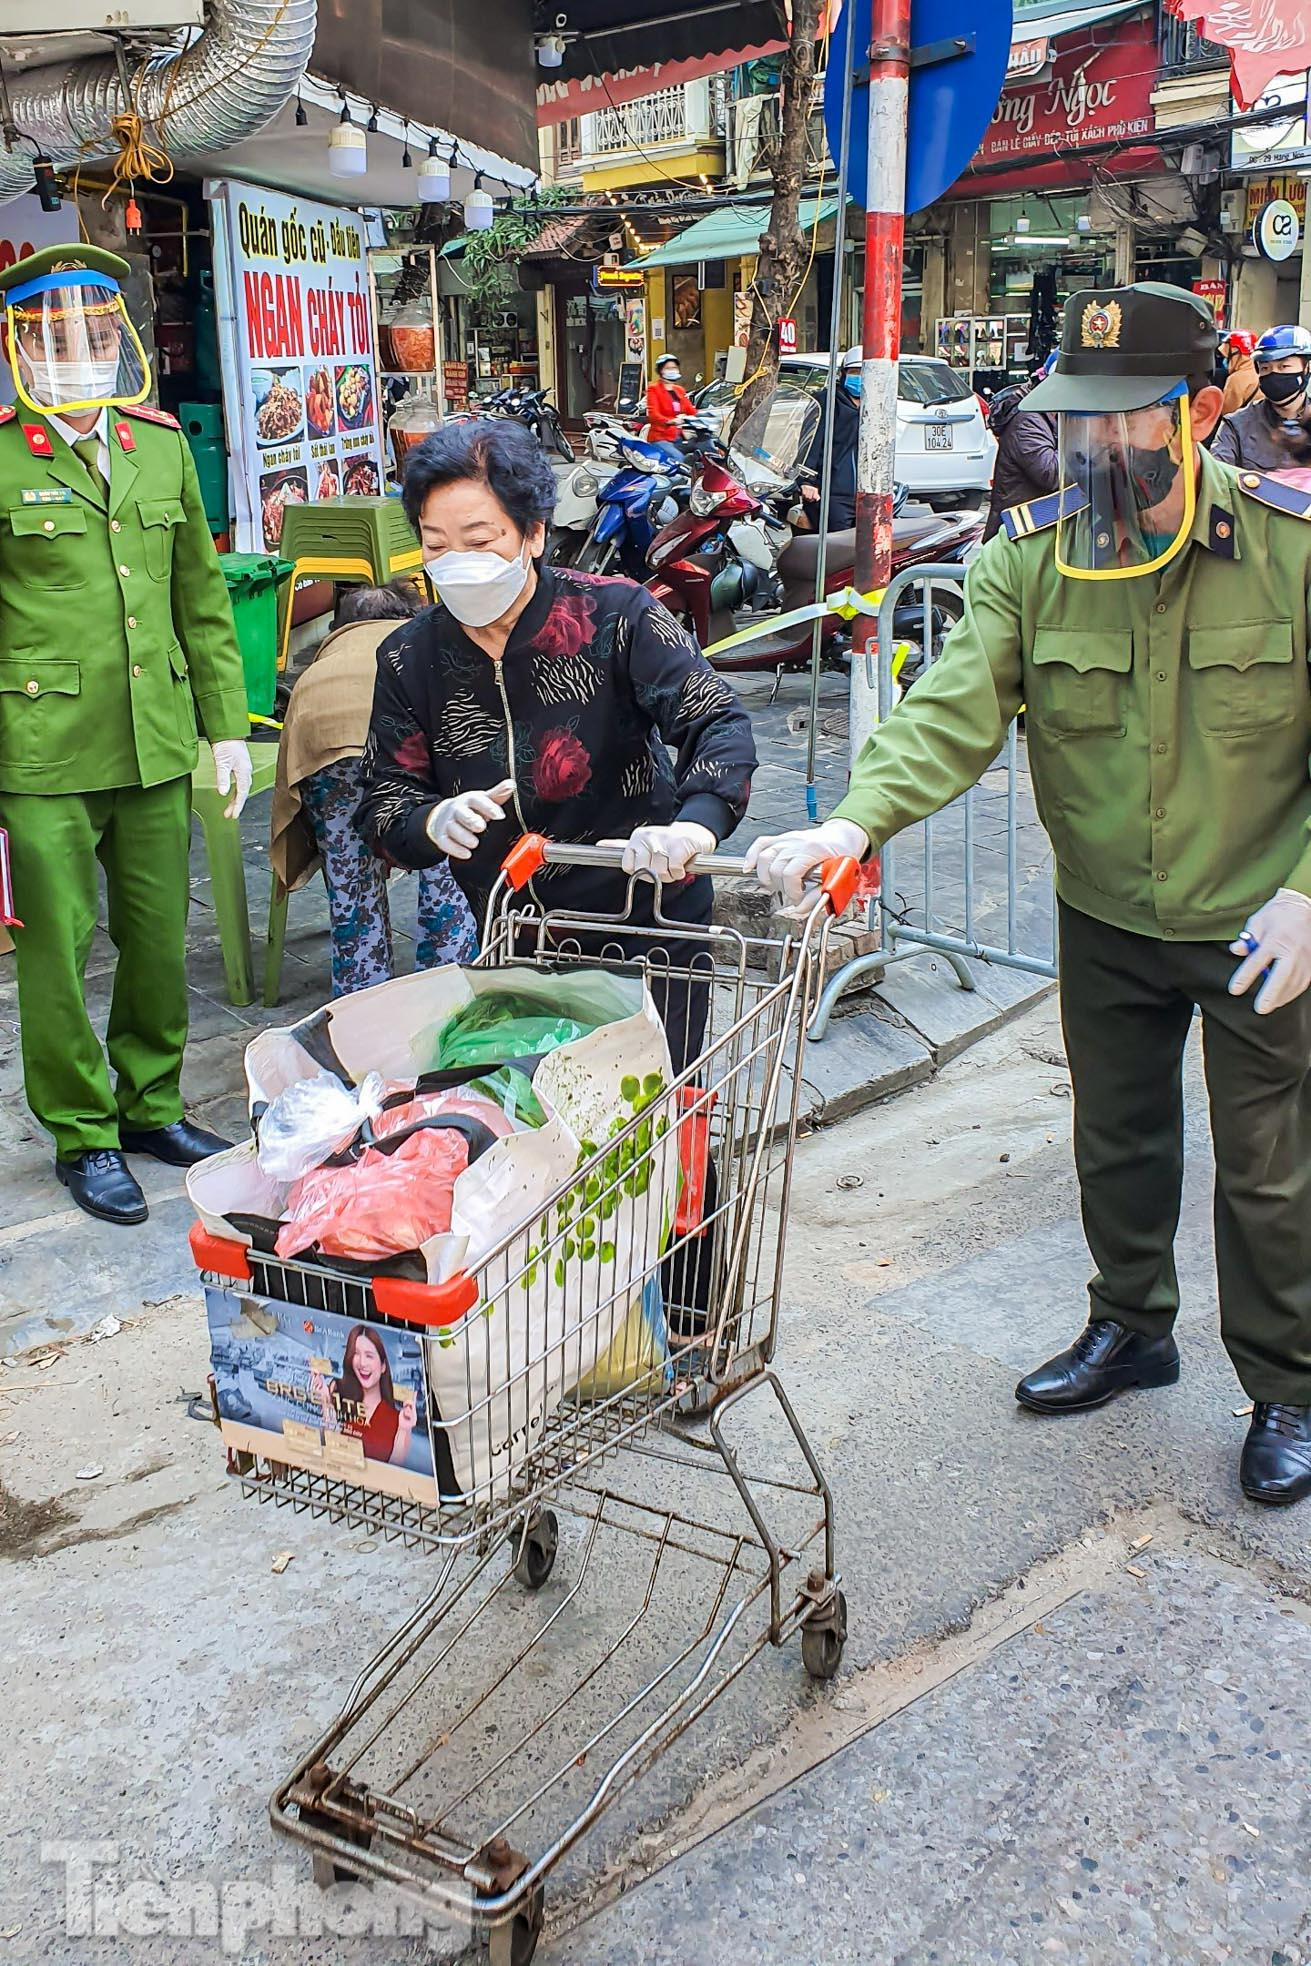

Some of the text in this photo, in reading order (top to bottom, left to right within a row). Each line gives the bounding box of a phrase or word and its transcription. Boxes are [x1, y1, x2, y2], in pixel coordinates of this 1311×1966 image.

[1044, 74, 1118, 126] Ngọc
[239, 202, 278, 259] Quán
[282, 207, 306, 264] gốc
[310, 219, 326, 264] cũ
[244, 271, 370, 359] NGAN CHÁY TỎI
[781, 321, 796, 344] 40
[932, 425, 947, 437] 30E
